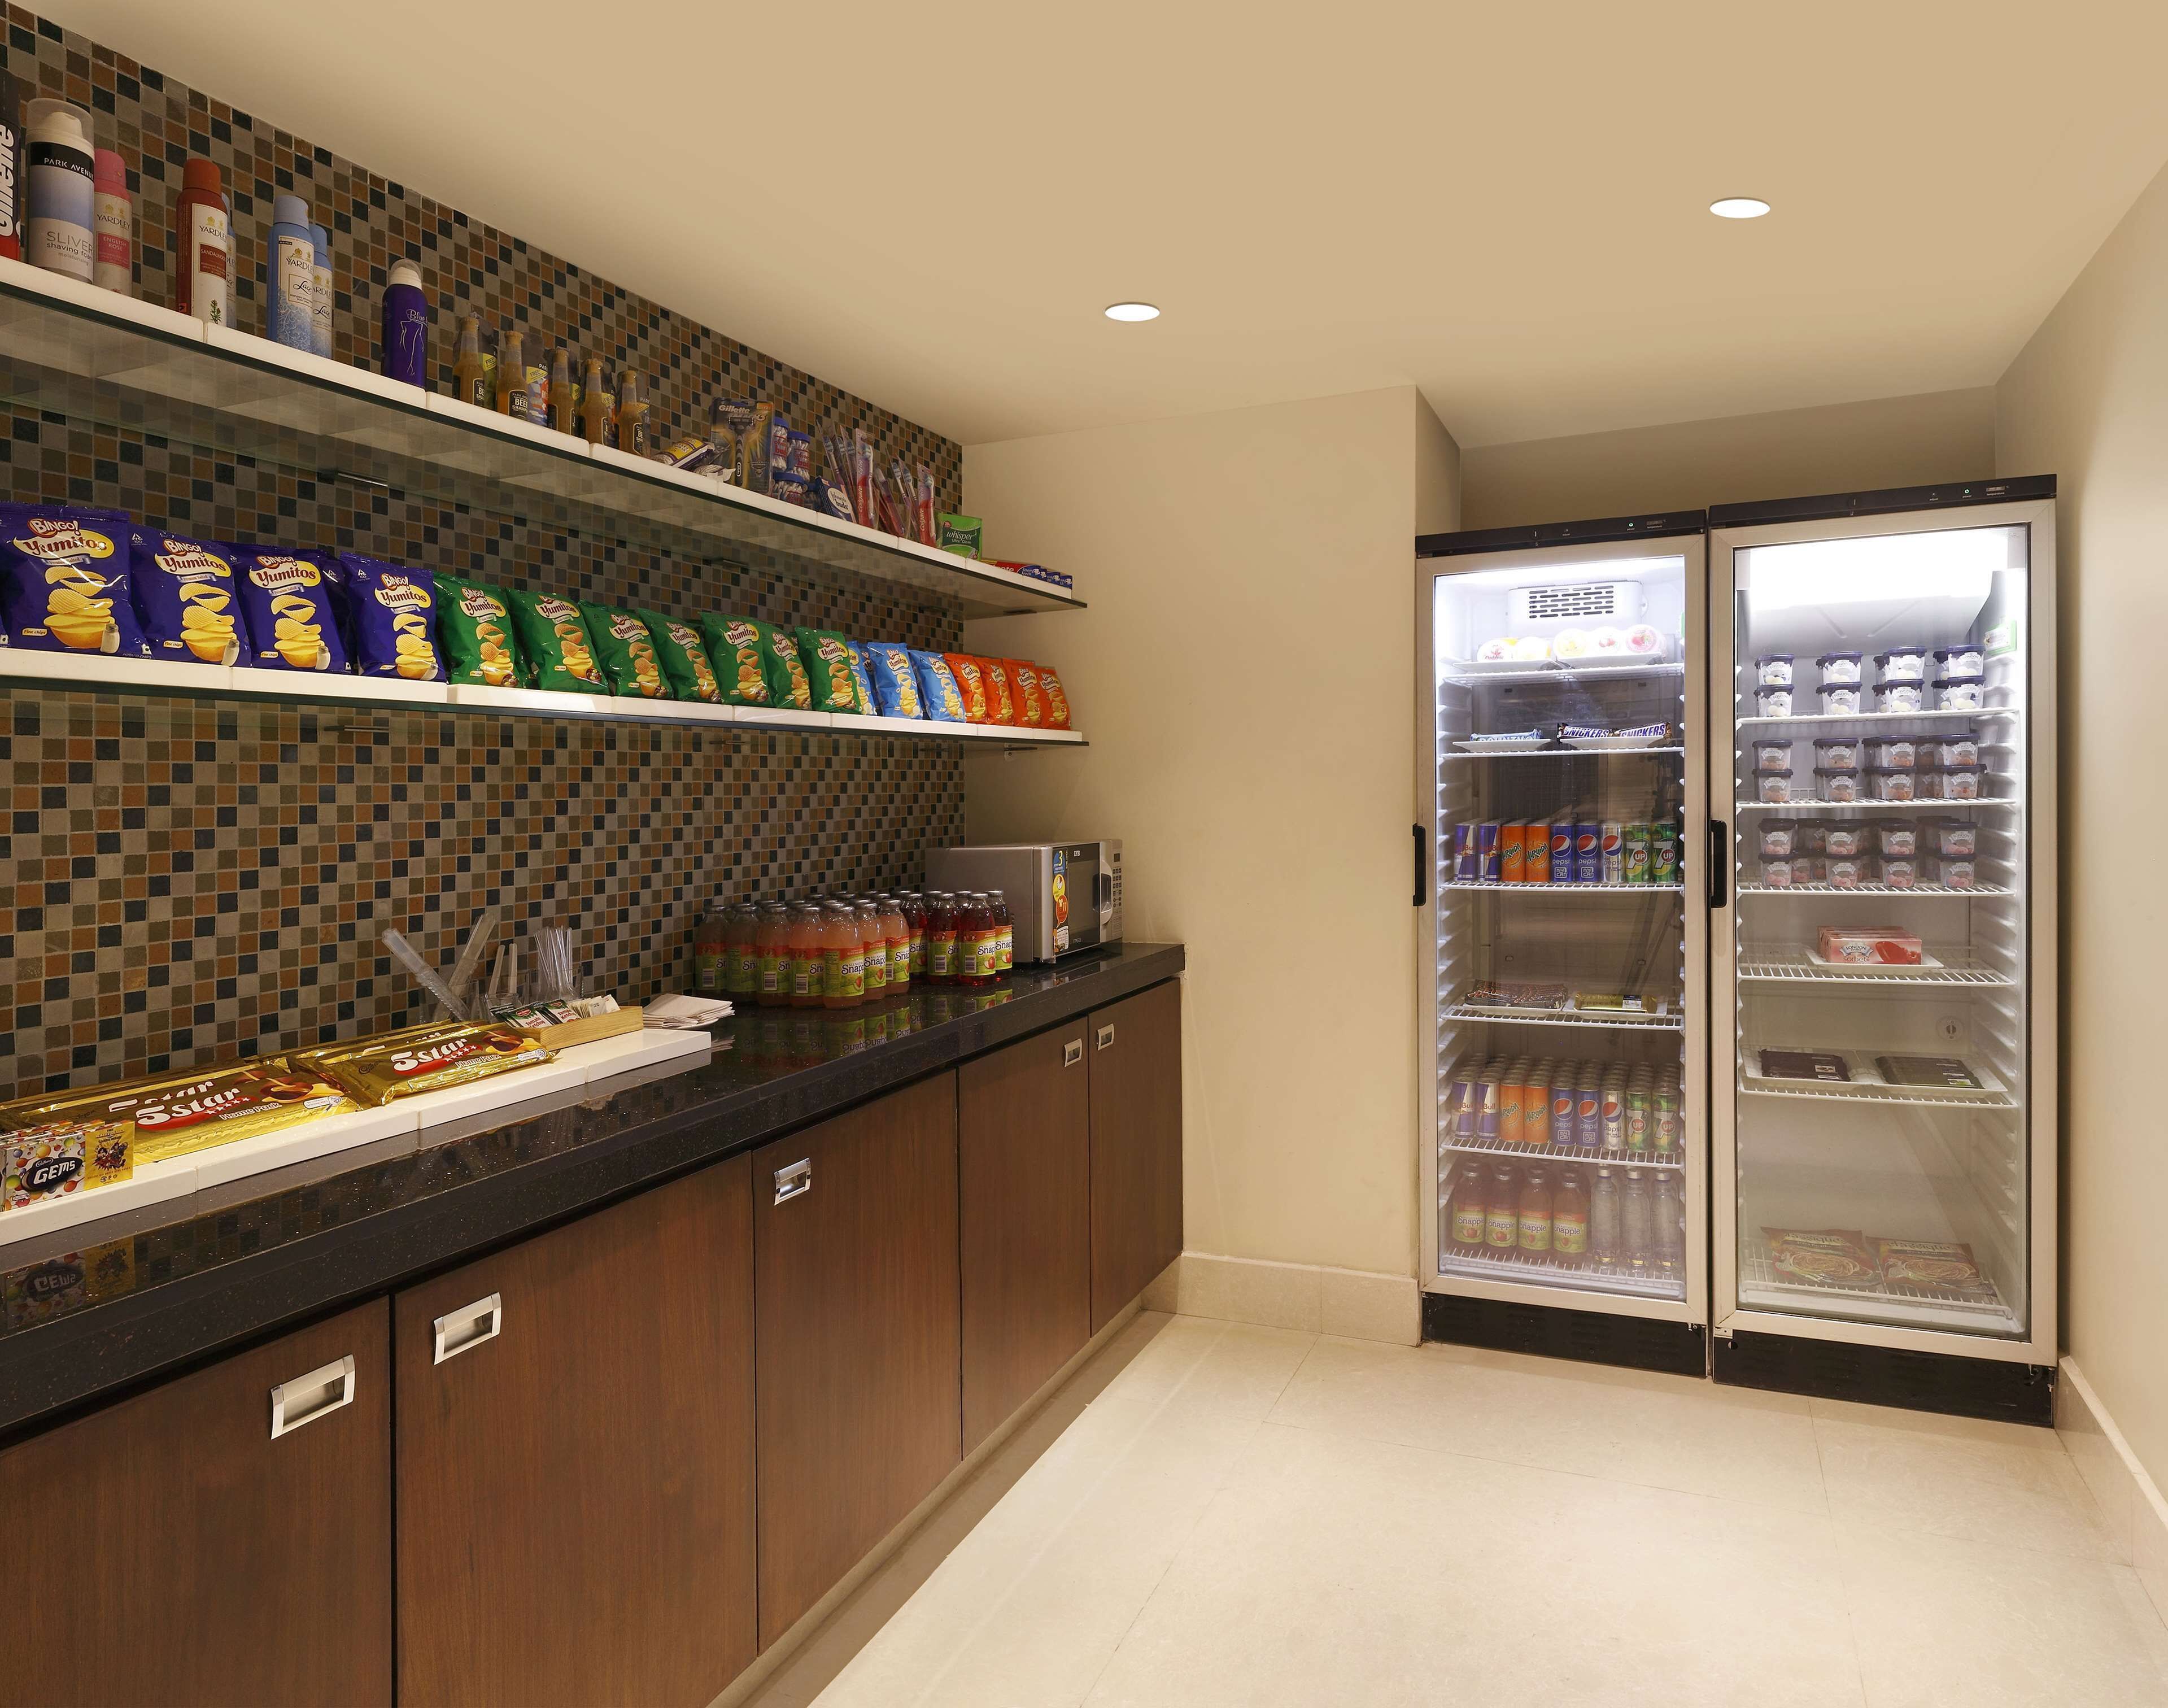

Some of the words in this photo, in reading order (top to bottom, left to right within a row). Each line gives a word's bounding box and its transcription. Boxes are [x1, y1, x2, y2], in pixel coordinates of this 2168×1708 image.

[44, 158, 67, 168] PARK
[71, 163, 94, 181] AVENUE
[97, 214, 130, 230] YARDLEY
[199, 225, 227, 240] YARDLE
[46, 231, 93, 253] SLIVER
[47, 242, 78, 255] shaving
[103, 236, 127, 247] ENGLISH
[108, 243, 123, 252] ROSE
[286, 258, 314, 274] YARDLE
[293, 280, 312, 295] Lace
[313, 305, 330, 320] Lace
[718, 404, 751, 413] Gillette
[33, 520, 81, 536] BINGO!
[946, 529, 974, 541] whisper
[23, 536, 108, 555] Yumitos
[165, 541, 205, 557] BINGO!
[163, 555, 226, 572] Yumitos
[261, 556, 295, 565] BINGO!
[256, 567, 316, 586] Yumitos
[382, 574, 409, 589] BINGO!
[381, 590, 427, 605] Yumitos
[465, 599, 502, 616] Yumitos
[540, 600, 576, 617] Yumitos
[615, 622, 646, 637] Yumitos
[672, 630, 697, 643] Yumitos
[727, 628, 757, 643] Yumitos
[821, 643, 846, 659] Yumitos
[889, 655, 908, 669] Yumitos
[1564, 727, 1609, 738] SNICKERS
[1058, 850, 1063, 866] 3
[525, 1017, 542, 1026] Tomato
[455, 1058, 481, 1068] Home
[219, 1107, 255, 1121] Home
[255, 1102, 282, 1113] Pack
[33, 1160, 76, 1185] GEMS
